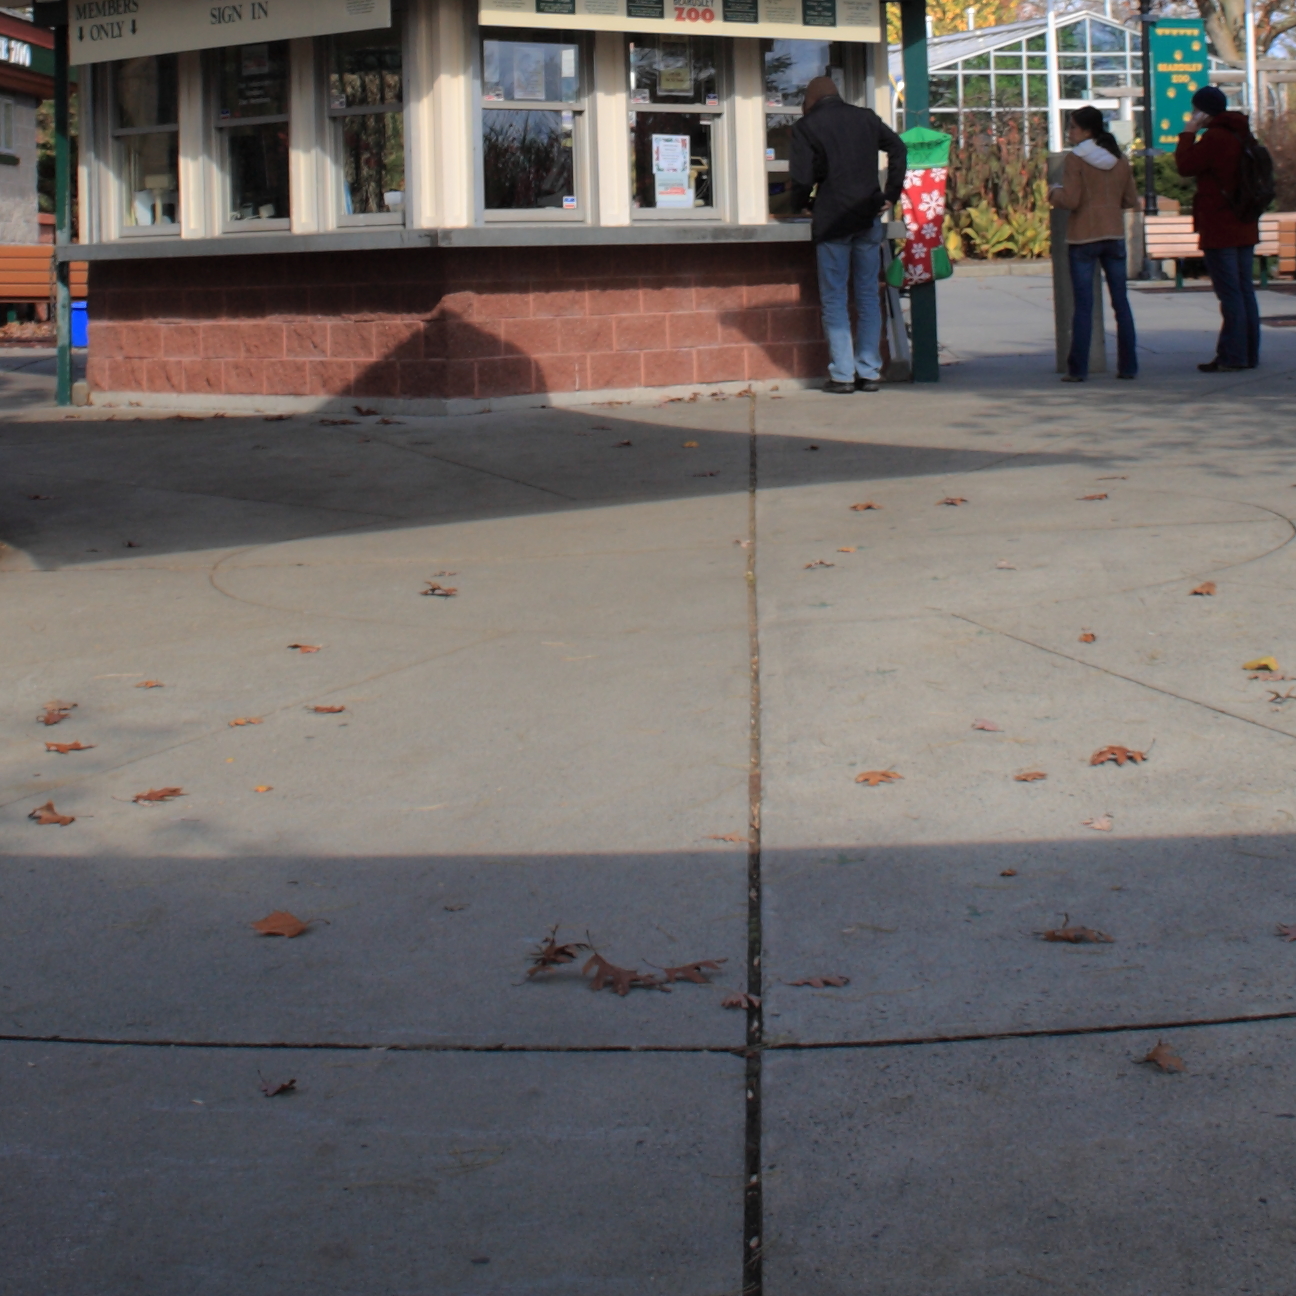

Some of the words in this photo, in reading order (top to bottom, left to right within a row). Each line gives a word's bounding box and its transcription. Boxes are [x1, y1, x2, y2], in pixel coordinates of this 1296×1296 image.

[210, 3, 242, 25] SIGN
[251, 1, 269, 20] IN
[674, 7, 715, 23] ZOO
[90, 21, 124, 42] ONLY
